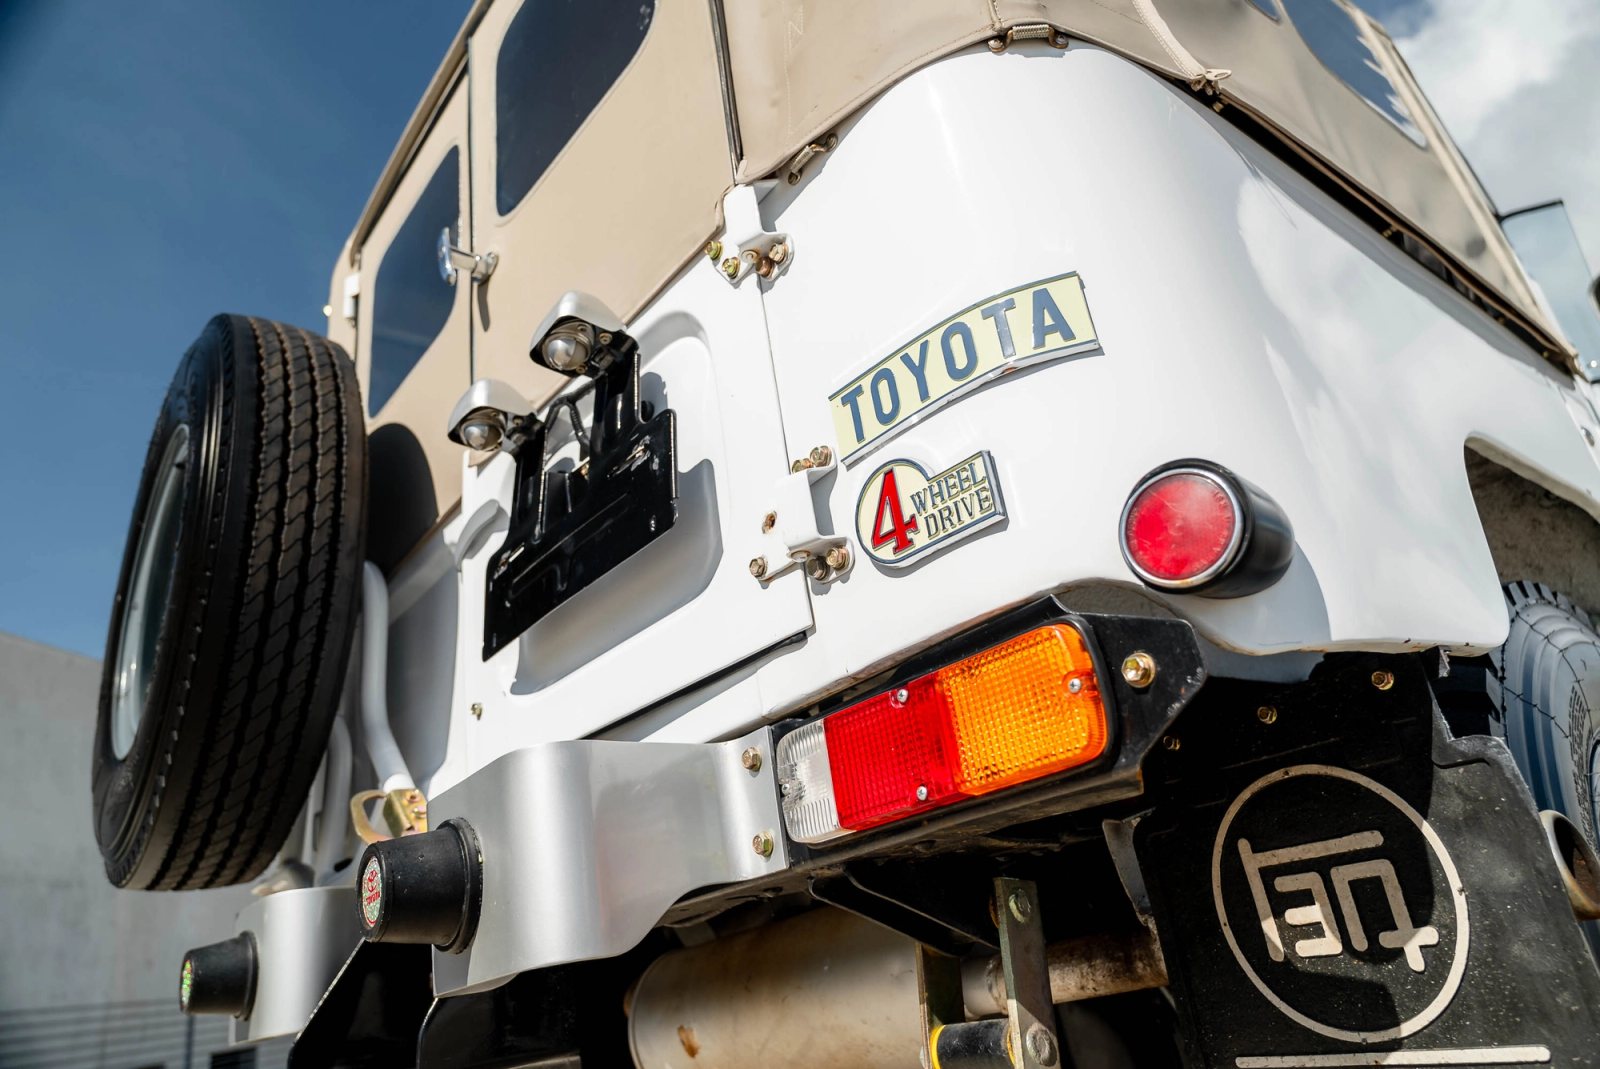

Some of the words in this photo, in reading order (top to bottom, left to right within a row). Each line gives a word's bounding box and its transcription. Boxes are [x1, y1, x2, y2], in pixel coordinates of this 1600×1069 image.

[841, 287, 1076, 443] TOYOTA
[871, 466, 919, 556] 4
[910, 463, 987, 516] WHEEL
[924, 486, 993, 540] DRIVE
